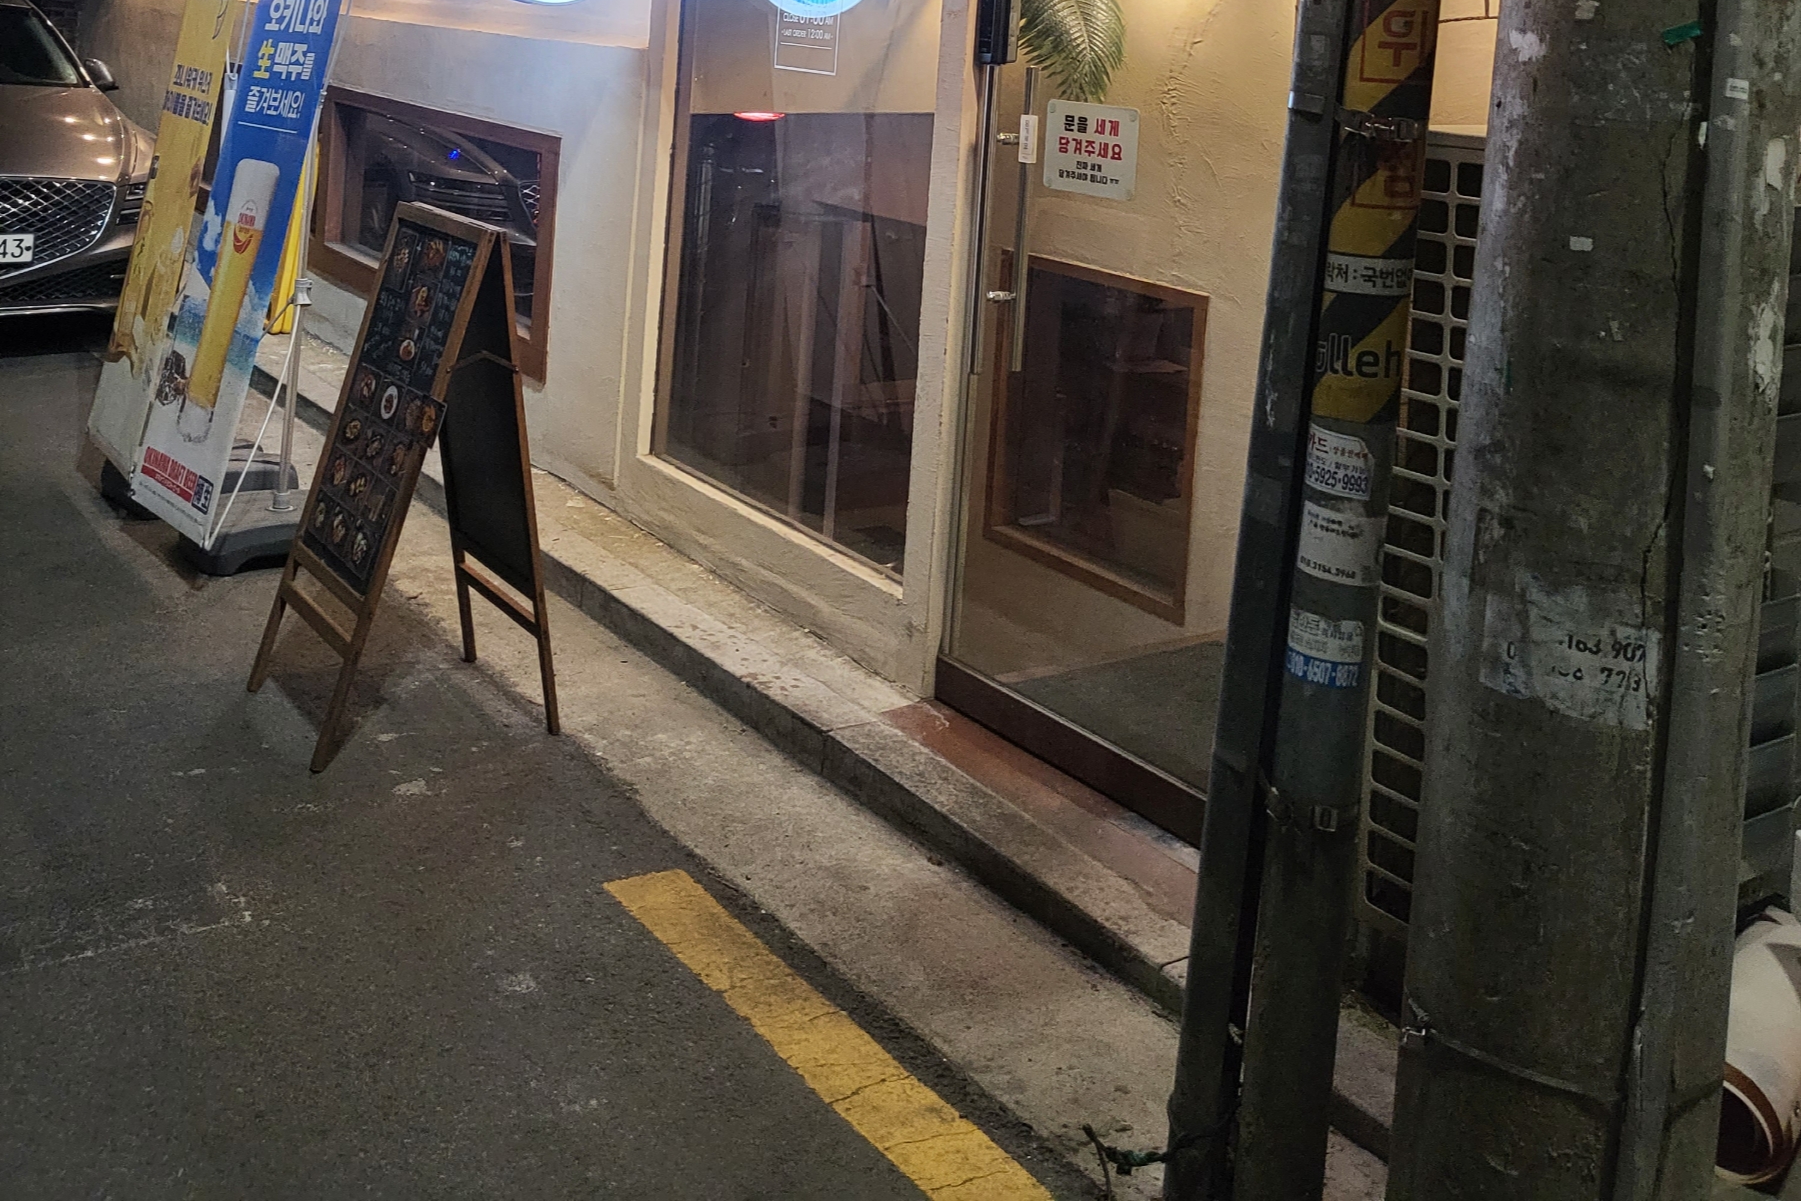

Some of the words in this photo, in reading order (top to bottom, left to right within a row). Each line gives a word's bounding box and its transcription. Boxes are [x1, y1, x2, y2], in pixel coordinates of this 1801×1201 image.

[244, 85, 306, 120] 즐겨보세요!
[1064, 114, 1089, 134] 문을
[1094, 117, 1120, 137] 세게
[1058, 136, 1123, 161] 당겨주세요
